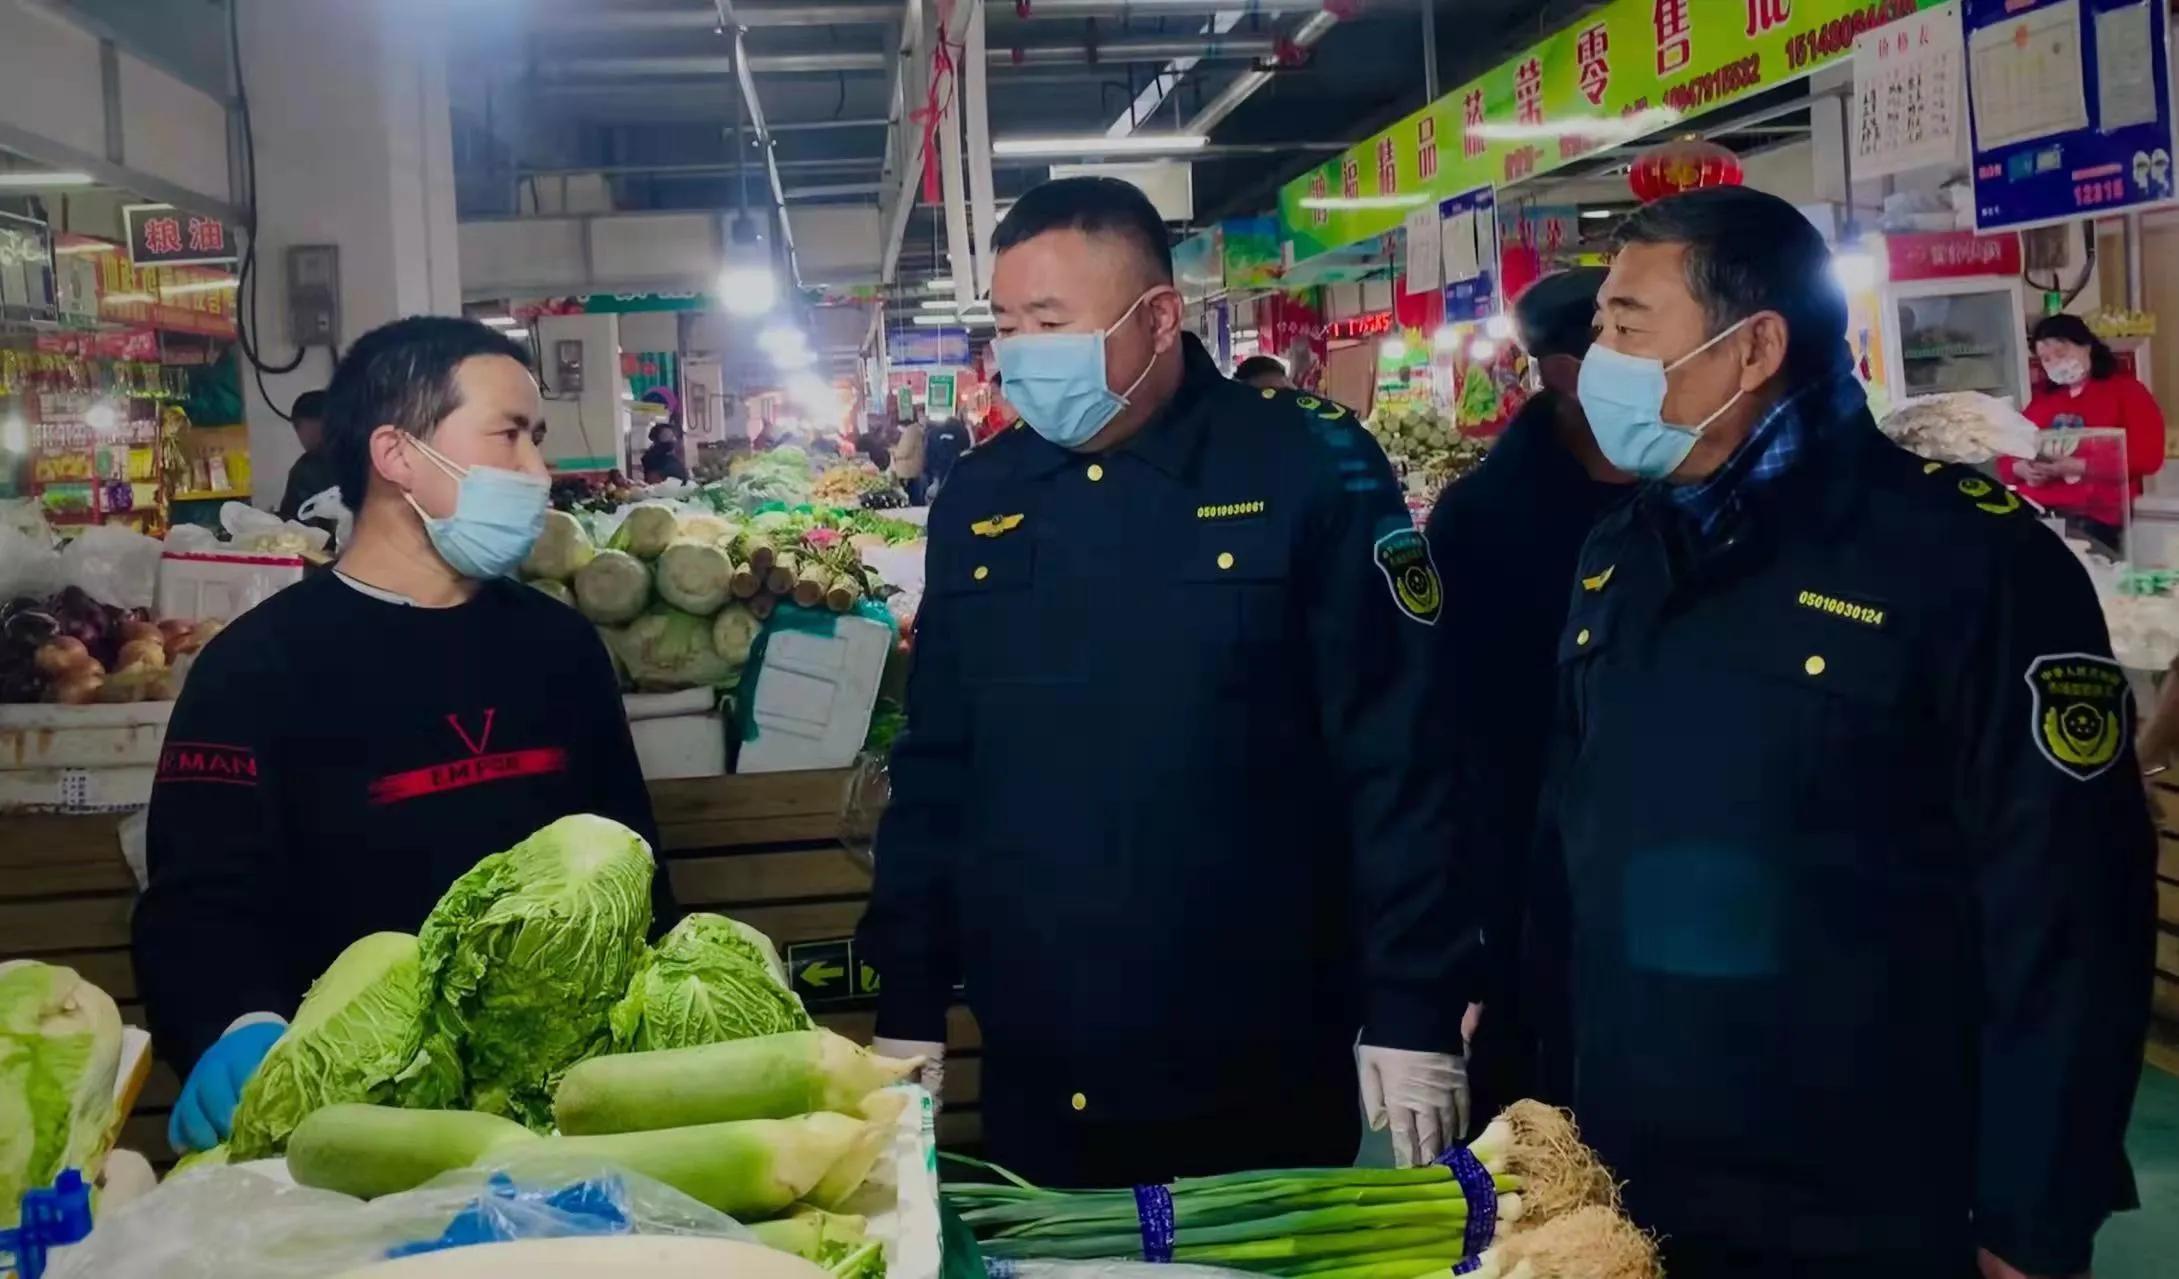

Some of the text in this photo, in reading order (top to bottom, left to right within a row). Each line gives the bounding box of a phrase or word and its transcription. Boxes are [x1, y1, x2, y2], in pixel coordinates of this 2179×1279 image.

[2073, 179, 2125, 206] 12315
[144, 217, 224, 253] 粮油
[1798, 590, 1884, 625] 05010030124
